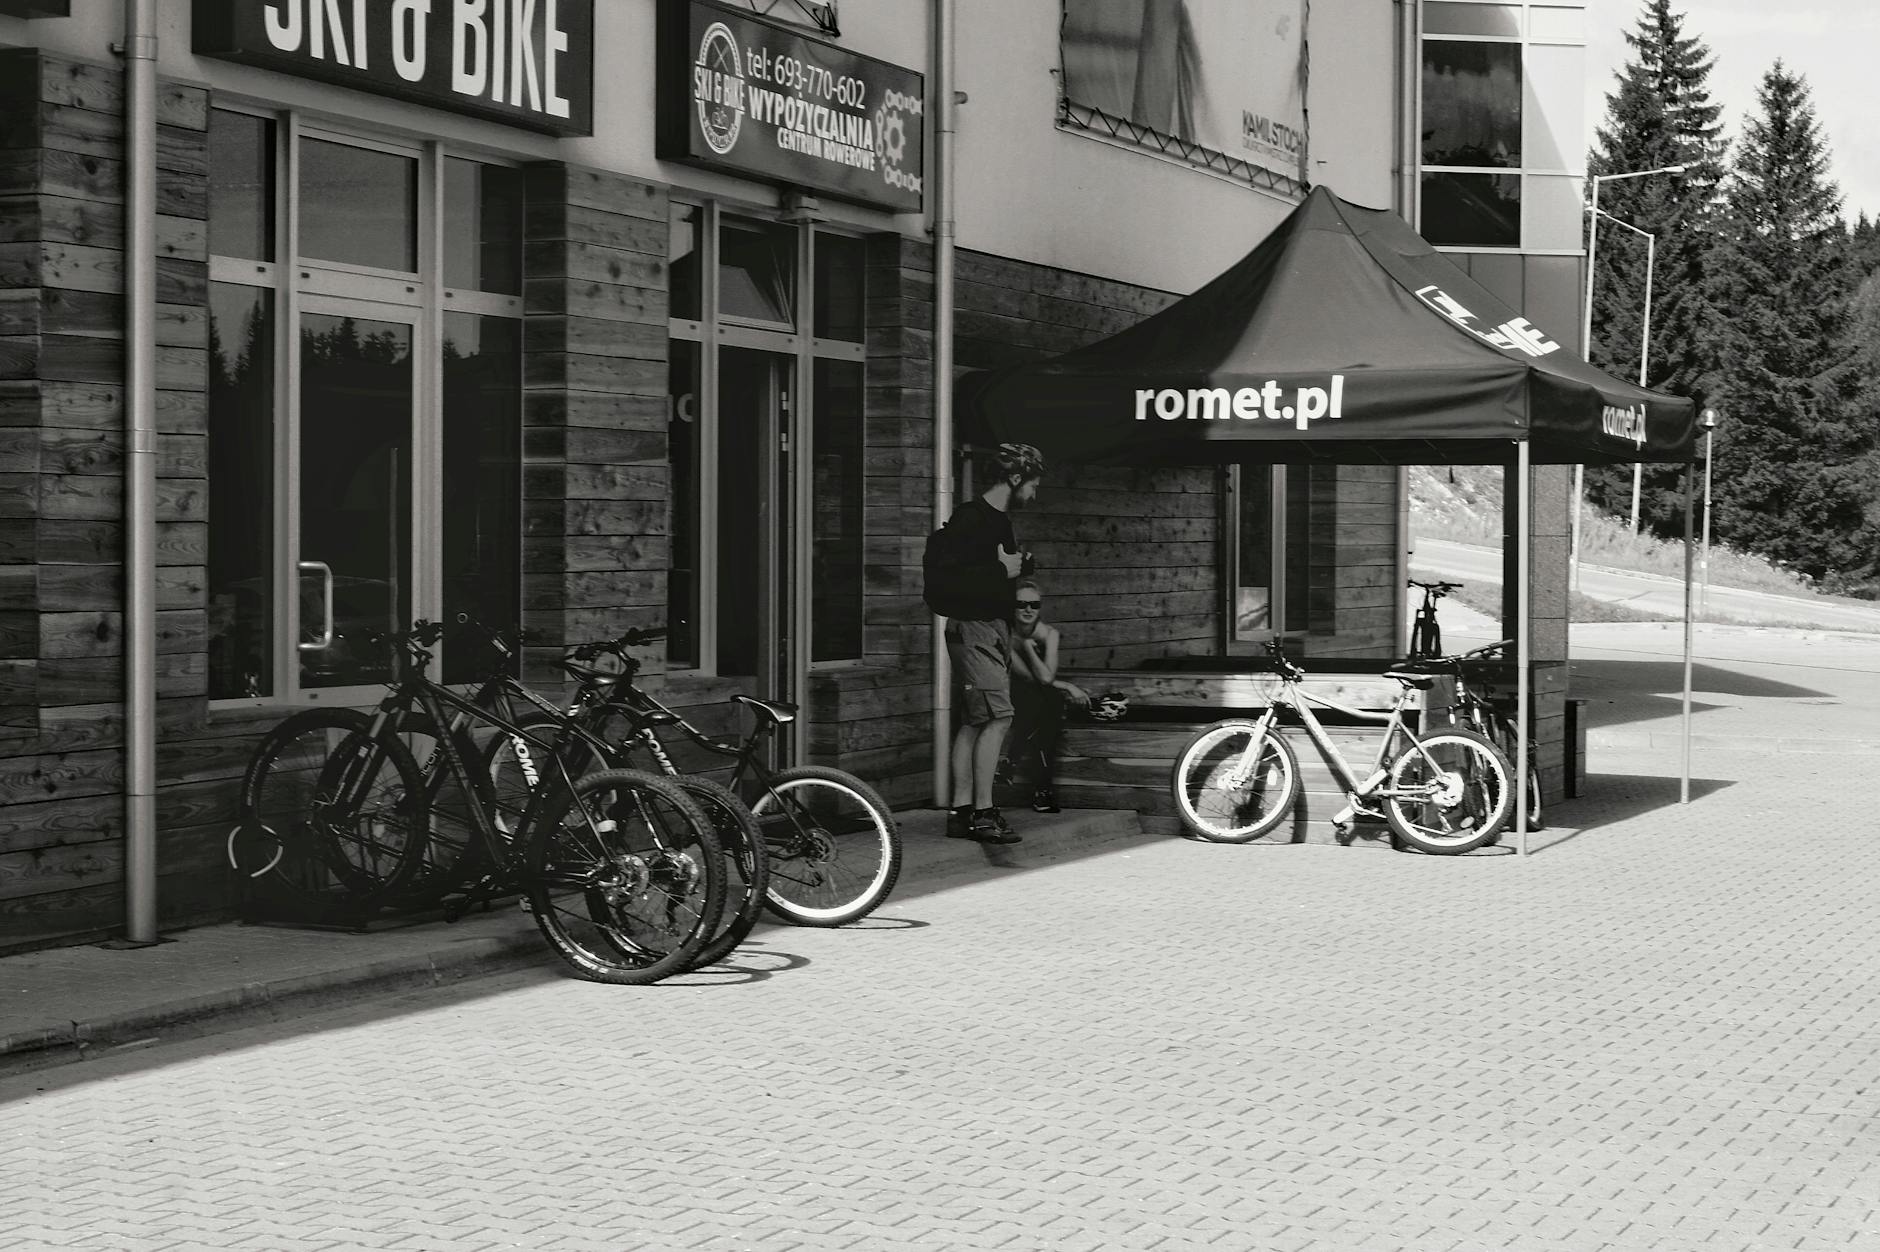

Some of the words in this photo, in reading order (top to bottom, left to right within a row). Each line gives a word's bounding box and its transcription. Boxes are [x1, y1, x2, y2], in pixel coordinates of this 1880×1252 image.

[451, 0, 570, 119] BIKE
[695, 65, 712, 101] SKI
[714, 71, 722, 104] &
[723, 73, 745, 111] BIKE
[746, 47, 771, 81] tel:
[775, 55, 866, 110] 693-770-602
[748, 85, 874, 151] WYPOŻYCZALNIA
[777, 127, 822, 159] CENTRUM
[1135, 374, 1344, 431] romet.pl
[1603, 403, 1647, 451] romet.pl
